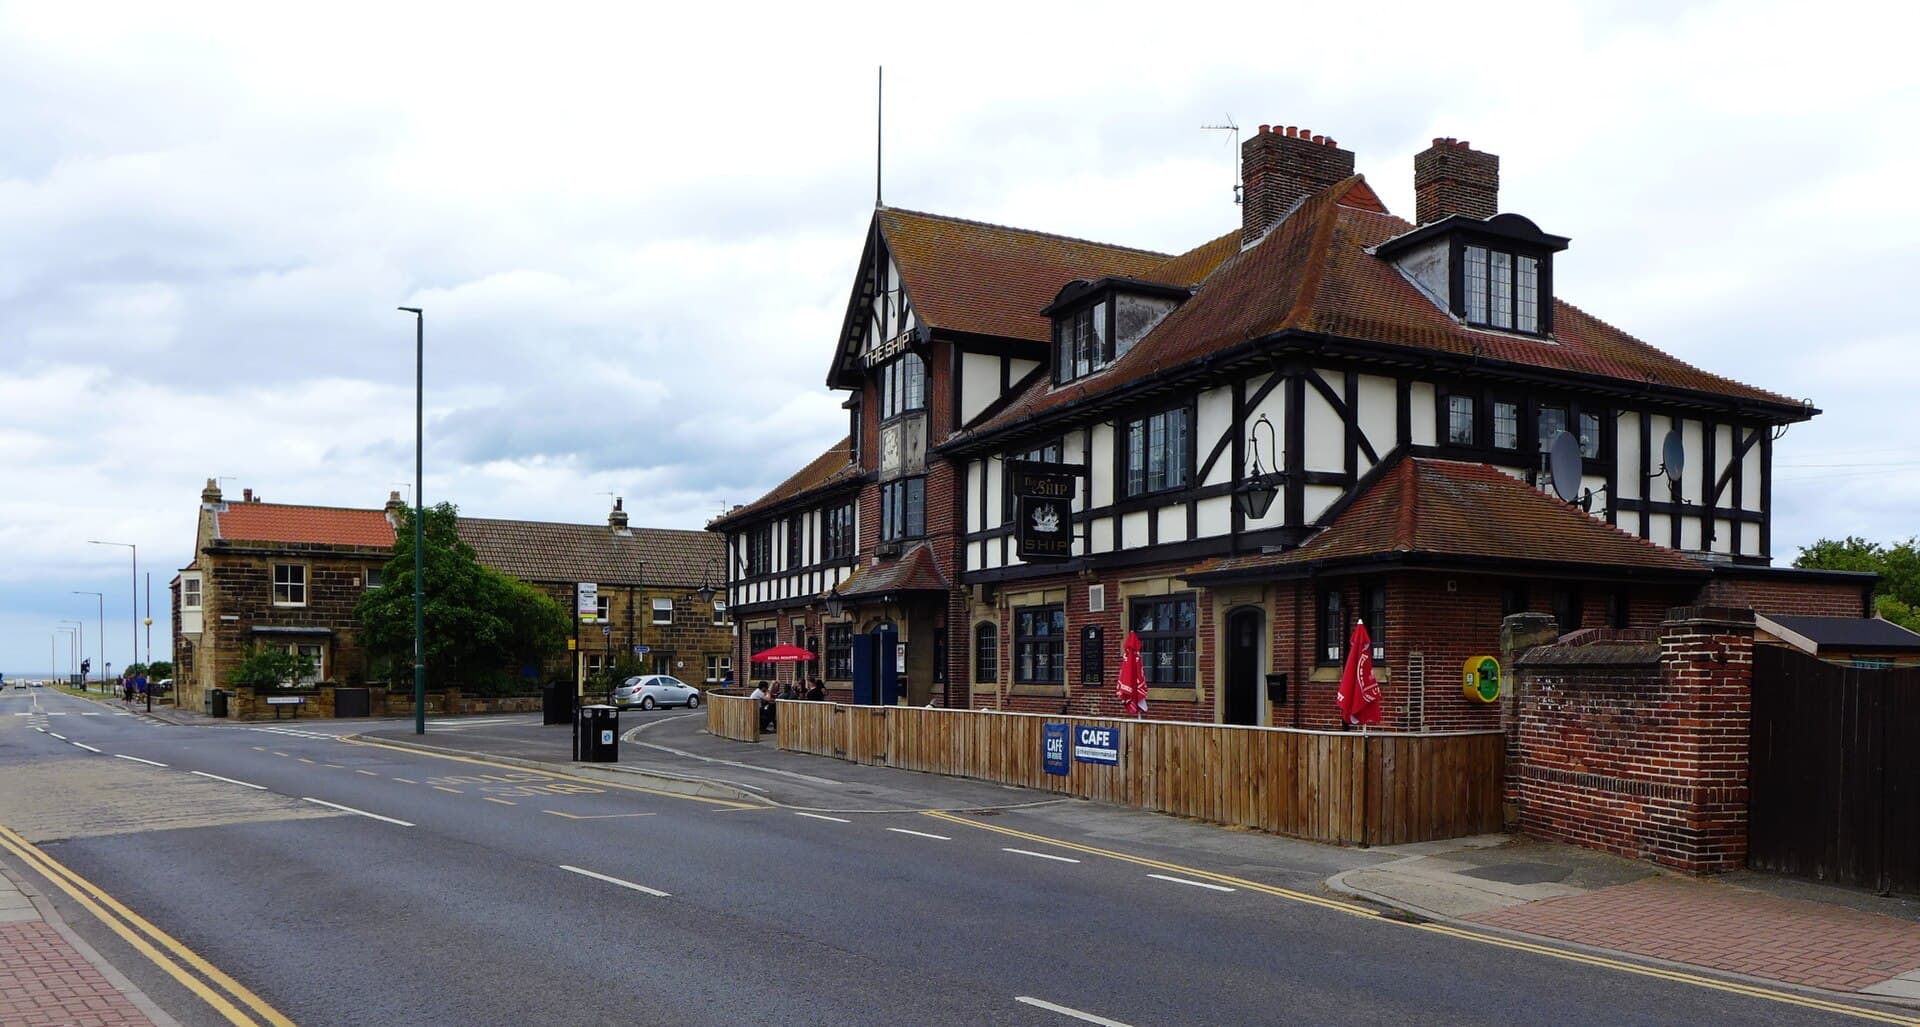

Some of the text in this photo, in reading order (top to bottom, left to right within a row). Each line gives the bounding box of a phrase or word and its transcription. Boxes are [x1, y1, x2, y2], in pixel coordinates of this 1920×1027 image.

[864, 333, 910, 368] THE SHIP
[1024, 539, 1067, 551] SHIP
[1081, 729, 1110, 746] CAFE
